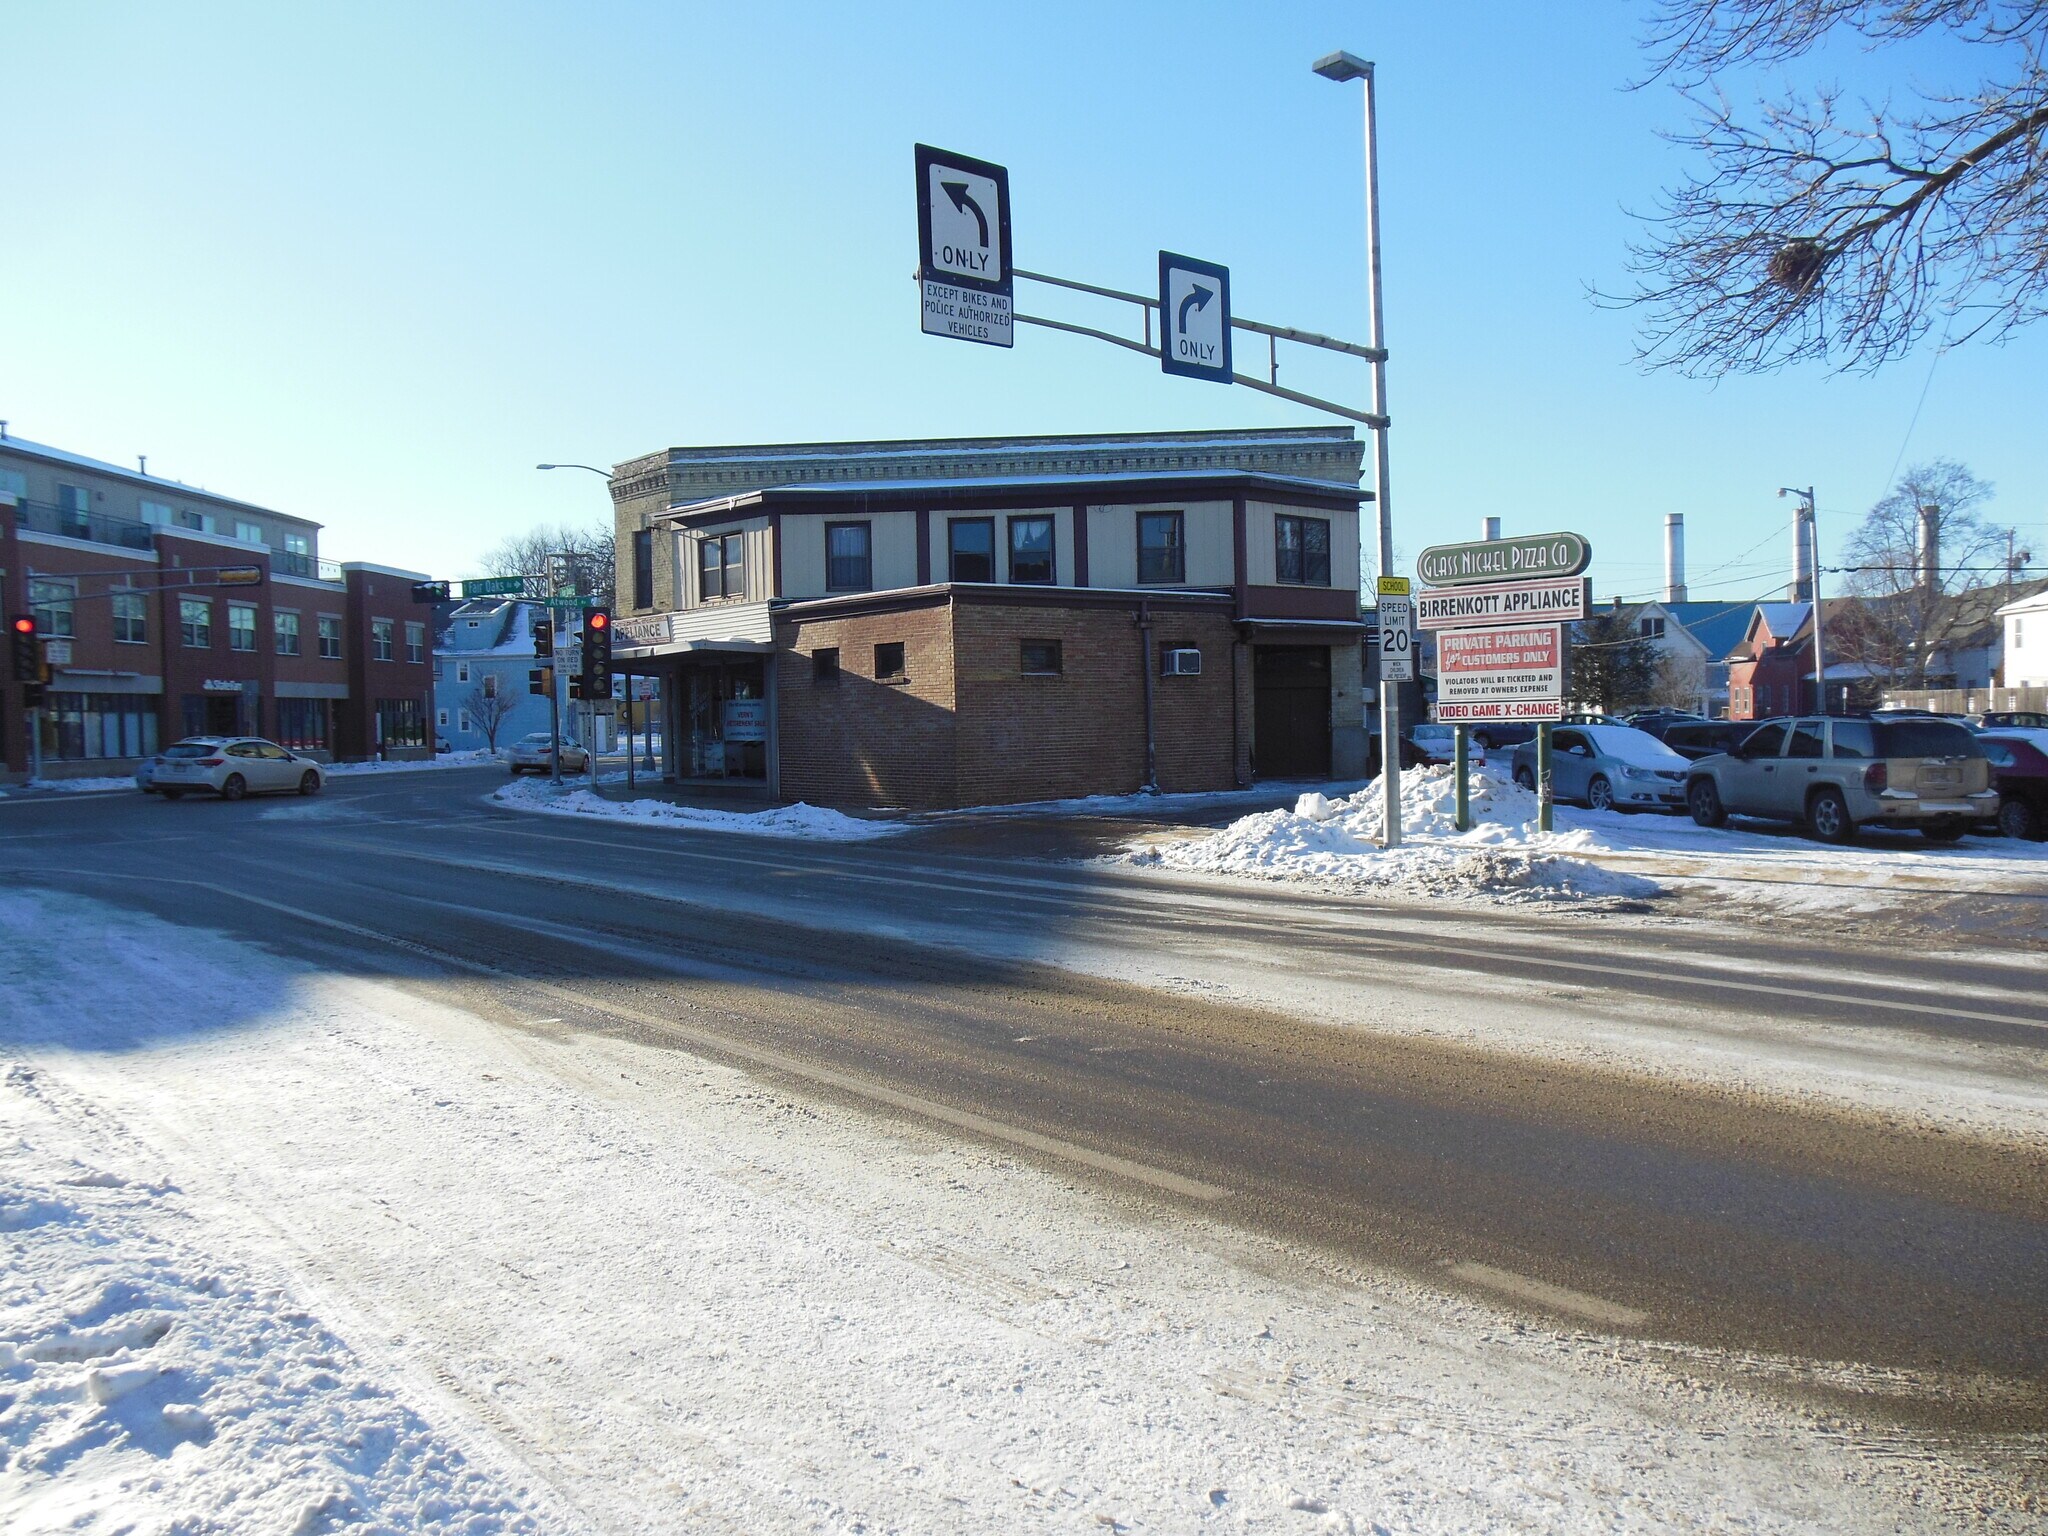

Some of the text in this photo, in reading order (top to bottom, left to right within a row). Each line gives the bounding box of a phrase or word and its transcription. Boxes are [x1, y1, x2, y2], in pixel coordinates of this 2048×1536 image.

[942, 245, 989, 271] ONLY
[927, 284, 1008, 310] EXCEPT BIKES AND
[925, 300, 1010, 326] POLICE AUTHORIZED
[948, 321, 989, 338] VEHICLES
[1180, 339, 1215, 360] ONLY
[468, 581, 483, 594] Fair
[485, 579, 505, 592] Oaks
[1382, 581, 1405, 592] SCHOOL
[549, 598, 578, 606] Atwood
[1381, 602, 1408, 613] SPEED
[1420, 588, 1580, 618] BIRRENKOTT APPLIANCE
[1384, 616, 1405, 626] LIMIT
[615, 623, 661, 641] APPLIANCE
[1383, 628, 1408, 652] 20
[1444, 631, 1552, 652] PRIVATE PARKING
[1445, 651, 1550, 671] for CUSTOMERS ONLY
[1445, 677, 1479, 685] VIOLATORS
[1480, 676, 1495, 684] WILL
[1507, 674, 1536, 683] TICKETED
[1449, 687, 1479, 695] REMOVED
[1490, 685, 1518, 694] OWNERS
[1520, 685, 1548, 693] EXPENSE
[1439, 702, 1560, 717] VIDEO GAME X-CHANGE
